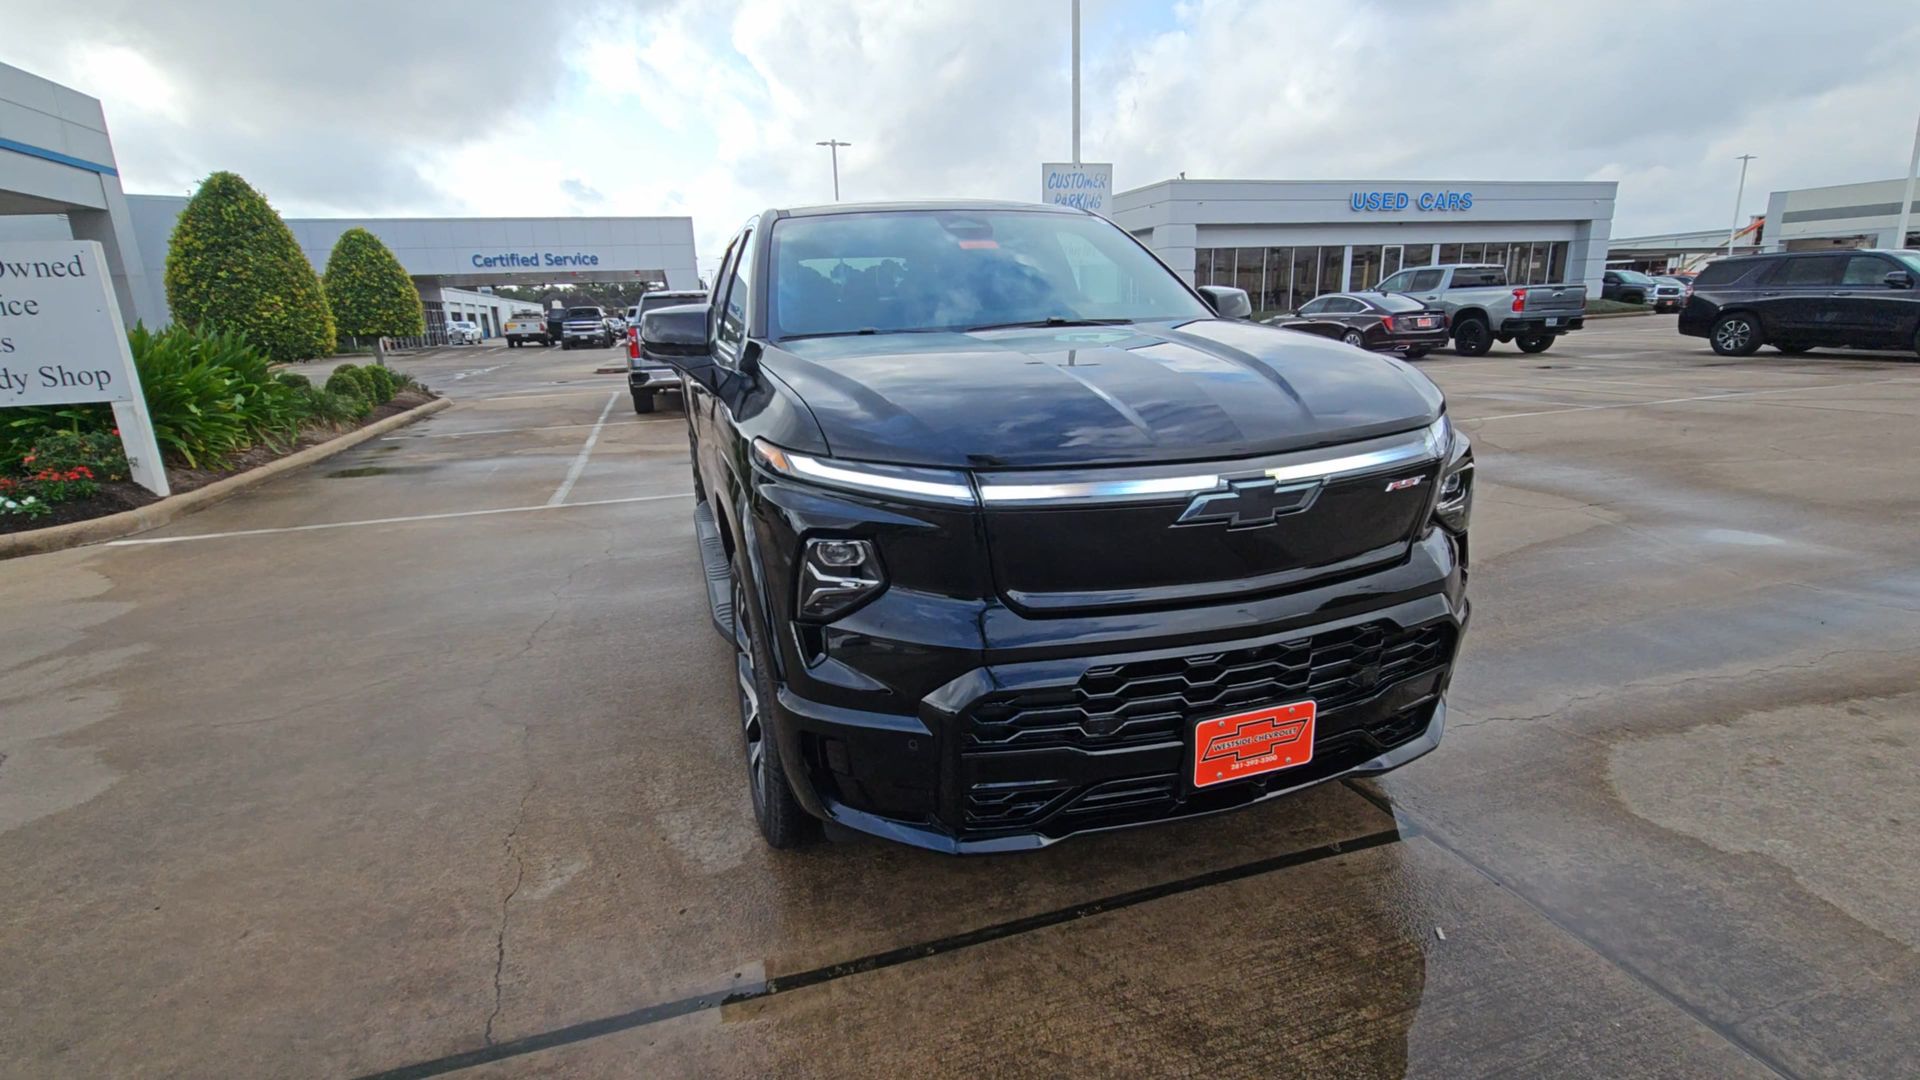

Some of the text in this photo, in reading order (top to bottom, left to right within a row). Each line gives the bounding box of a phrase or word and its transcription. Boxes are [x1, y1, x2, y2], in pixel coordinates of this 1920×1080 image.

[1352, 191, 1474, 210] USED CARS
[471, 251, 599, 268] Certified Service
[38, 364, 112, 391] Shop
[1213, 727, 1298, 751] WESTSIDE CHEVROLET
